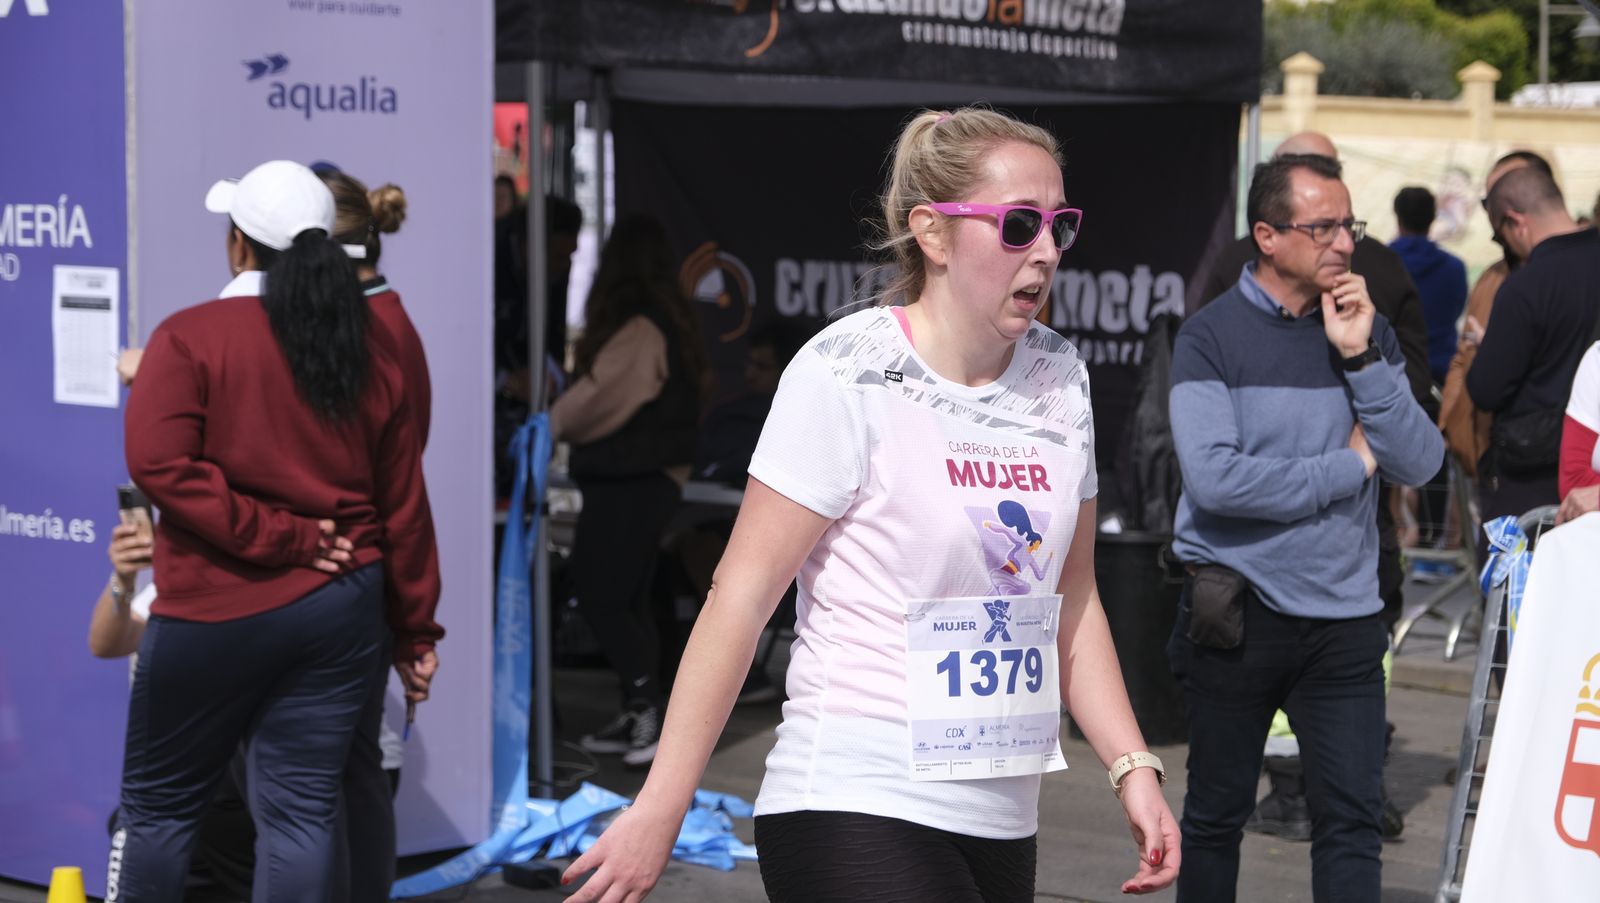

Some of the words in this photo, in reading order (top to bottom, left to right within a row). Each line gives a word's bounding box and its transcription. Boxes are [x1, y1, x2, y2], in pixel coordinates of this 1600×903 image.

[902, 20, 1028, 53] cronometraje
[1030, 31, 1118, 60] deportivo
[266, 75, 398, 120] aqualia
[948, 440, 1000, 458] CARRERA
[1003, 446, 1020, 459] DE
[1022, 446, 1039, 459] LA
[945, 458, 1052, 492] MUJER
[933, 621, 977, 632] MUJER
[936, 647, 1043, 698] 1379
